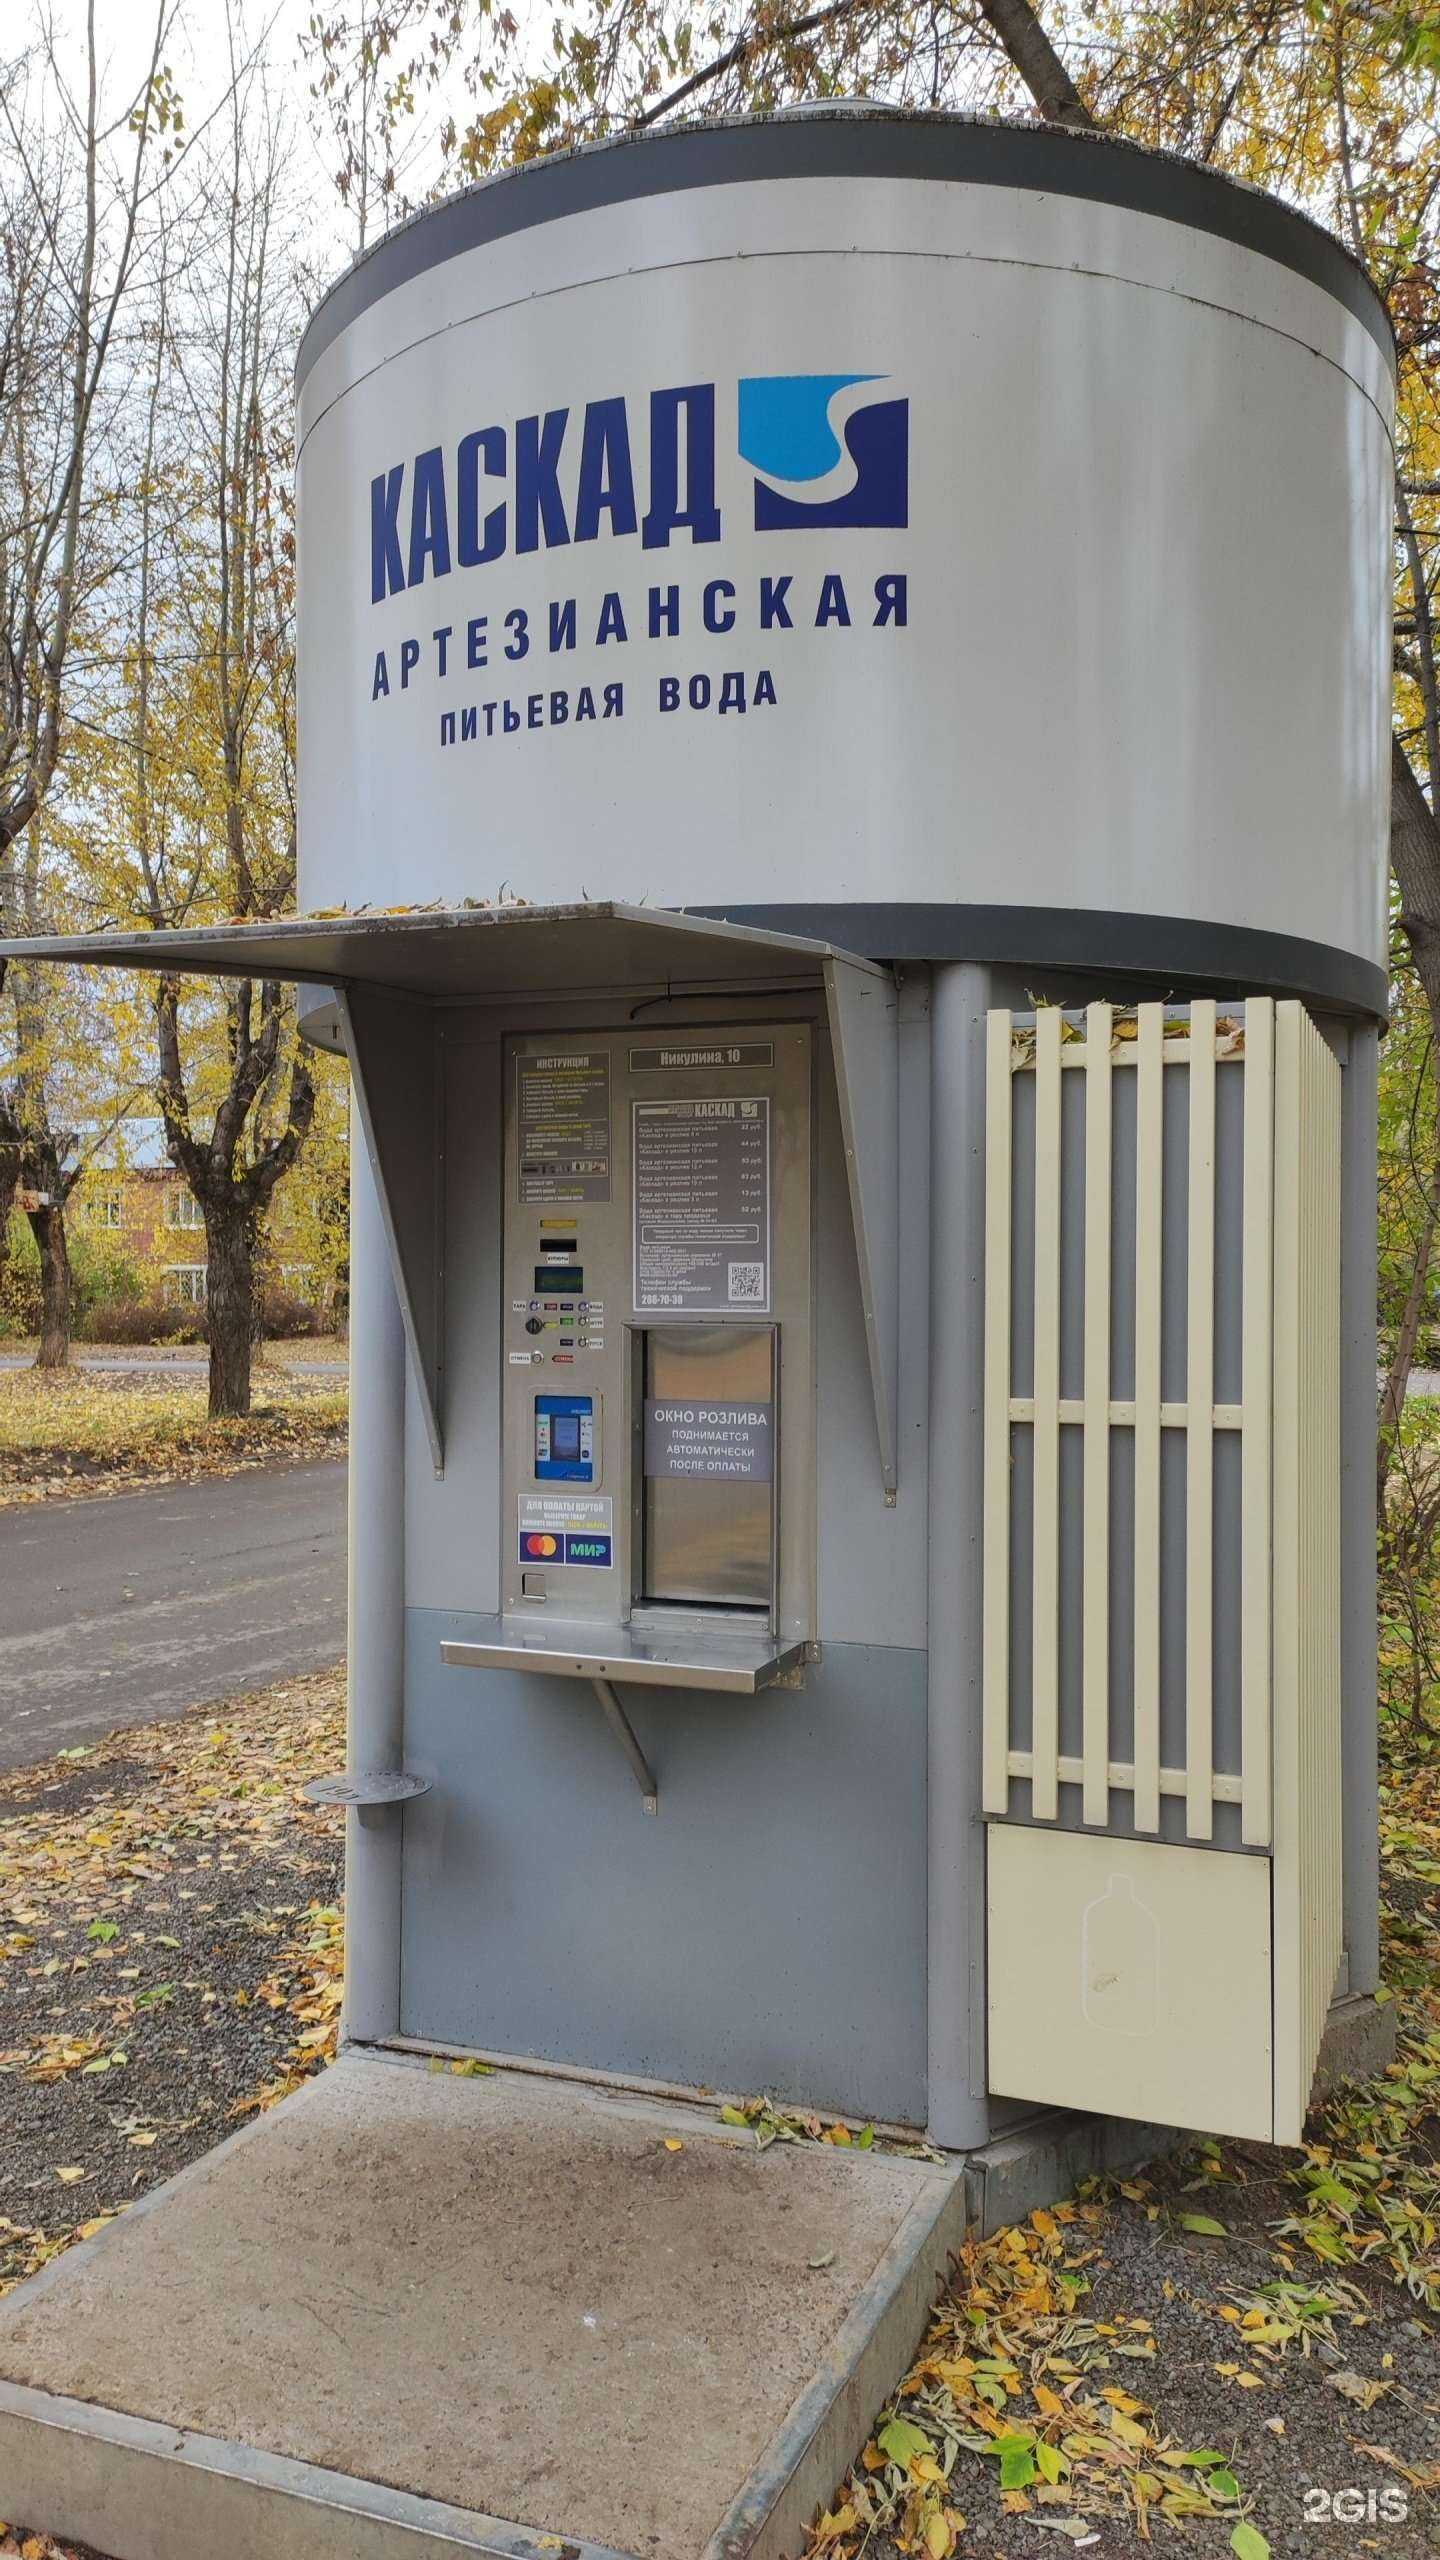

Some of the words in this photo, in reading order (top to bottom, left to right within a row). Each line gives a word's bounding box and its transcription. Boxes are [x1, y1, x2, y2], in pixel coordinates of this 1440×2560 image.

[371, 382, 722, 606] КАСКАД
[372, 573, 909, 701] АРТЕЗИАНСКАЯ
[440, 682, 625, 747] ПИТЬЕВАЯ
[658, 669, 778, 715] ВОДА
[727, 1048, 741, 1064] 10
[694, 1102, 736, 1119] КАСКАД
[654, 1410, 695, 1423] ОКНО
[698, 1411, 768, 1426] РОЗЛИВА
[672, 1430, 749, 1442] ПОДНИМАЕТСЯ
[666, 1444, 755, 1457] АВТОМАТИЧЕСКИ
[670, 1460, 705, 1471] ПОСЛЕ
[706, 1461, 751, 1473] ОПЛАТЫ
[570, 1543, 607, 1557] МИР
